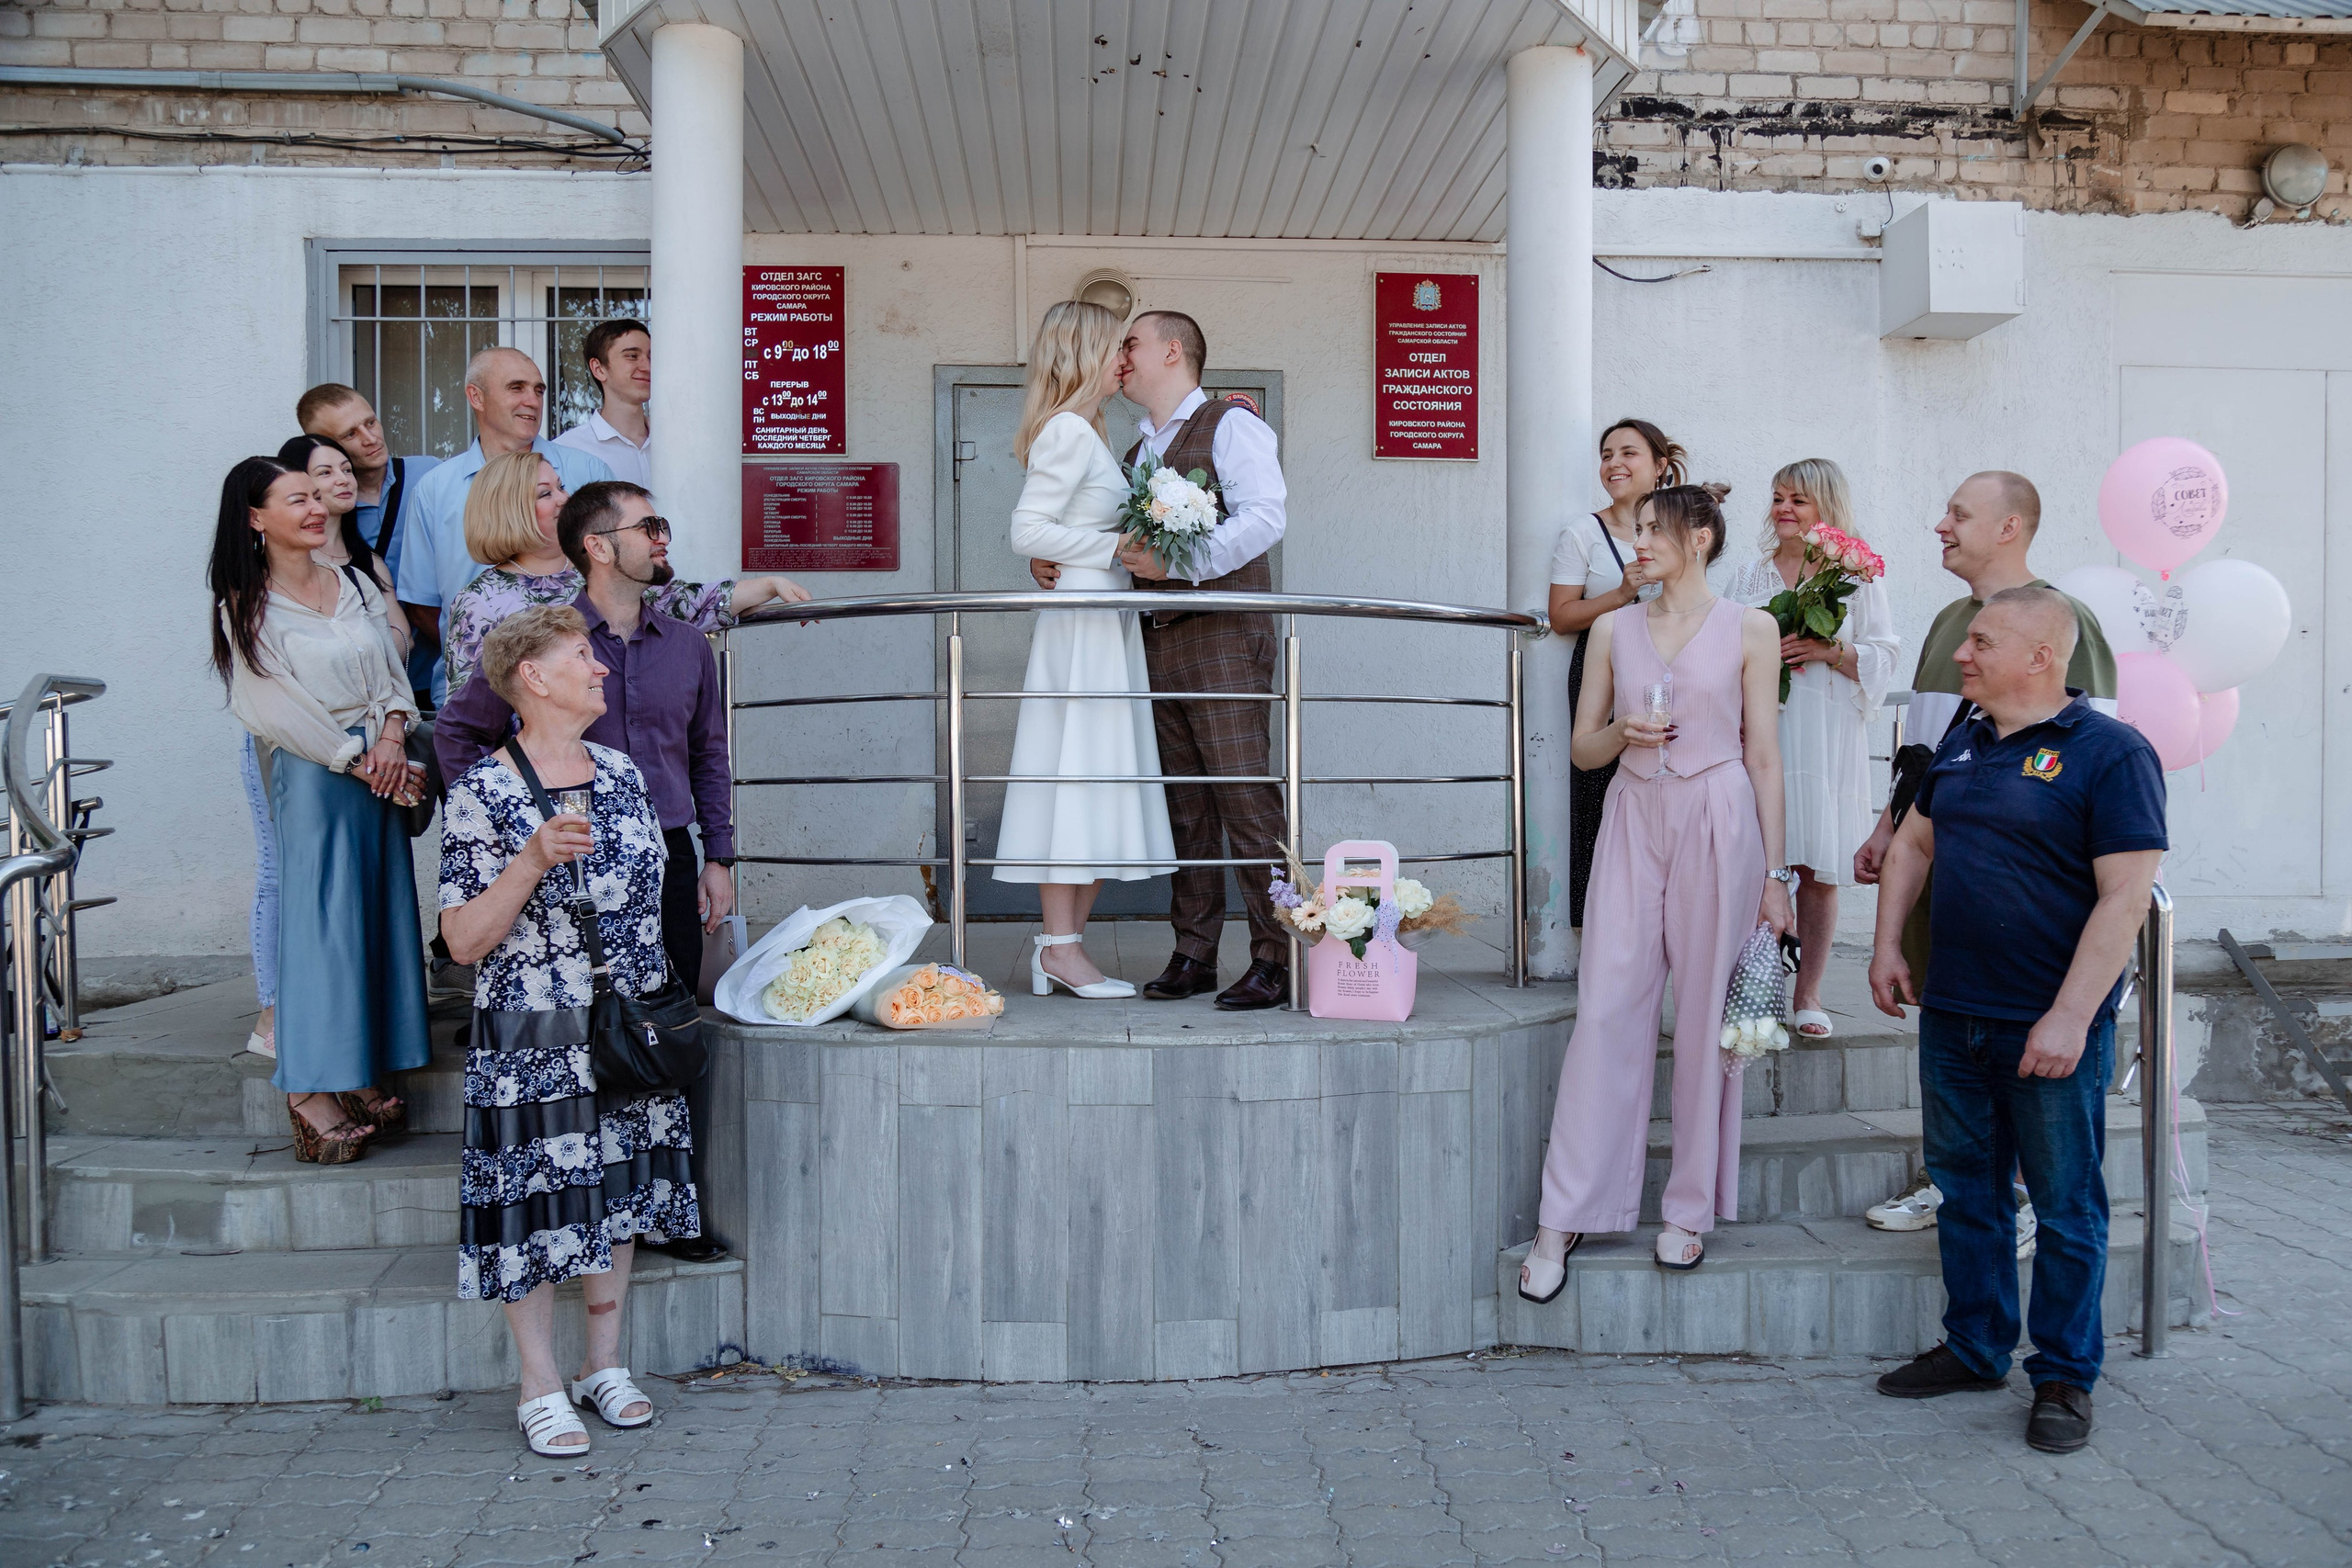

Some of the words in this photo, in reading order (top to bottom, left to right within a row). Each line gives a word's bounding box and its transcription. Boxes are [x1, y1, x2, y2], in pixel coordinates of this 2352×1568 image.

[761, 273, 794, 282] ОТДЕЛ
[751, 313, 787, 321] РЕЖИМ
[791, 313, 832, 321] РАБОТЫ
[744, 327, 758, 336] ВТ
[744, 338, 758, 347] СР
[792, 349, 809, 361] до
[1409, 353, 1446, 364] ОТДЕЛ
[744, 360, 758, 368] ПТ
[744, 371, 759, 380] СБ
[1385, 368, 1430, 378] ЗАПИСИ
[1433, 369, 1470, 379] АКТОВ
[1383, 384, 1472, 395] ГРАЖДАНСКОГО
[791, 397, 803, 407] до
[1393, 400, 1462, 411] СОСТОЯНИЯ
[1339, 961, 1378, 970] FRESH
[1337, 969, 1380, 977] FLOWER
